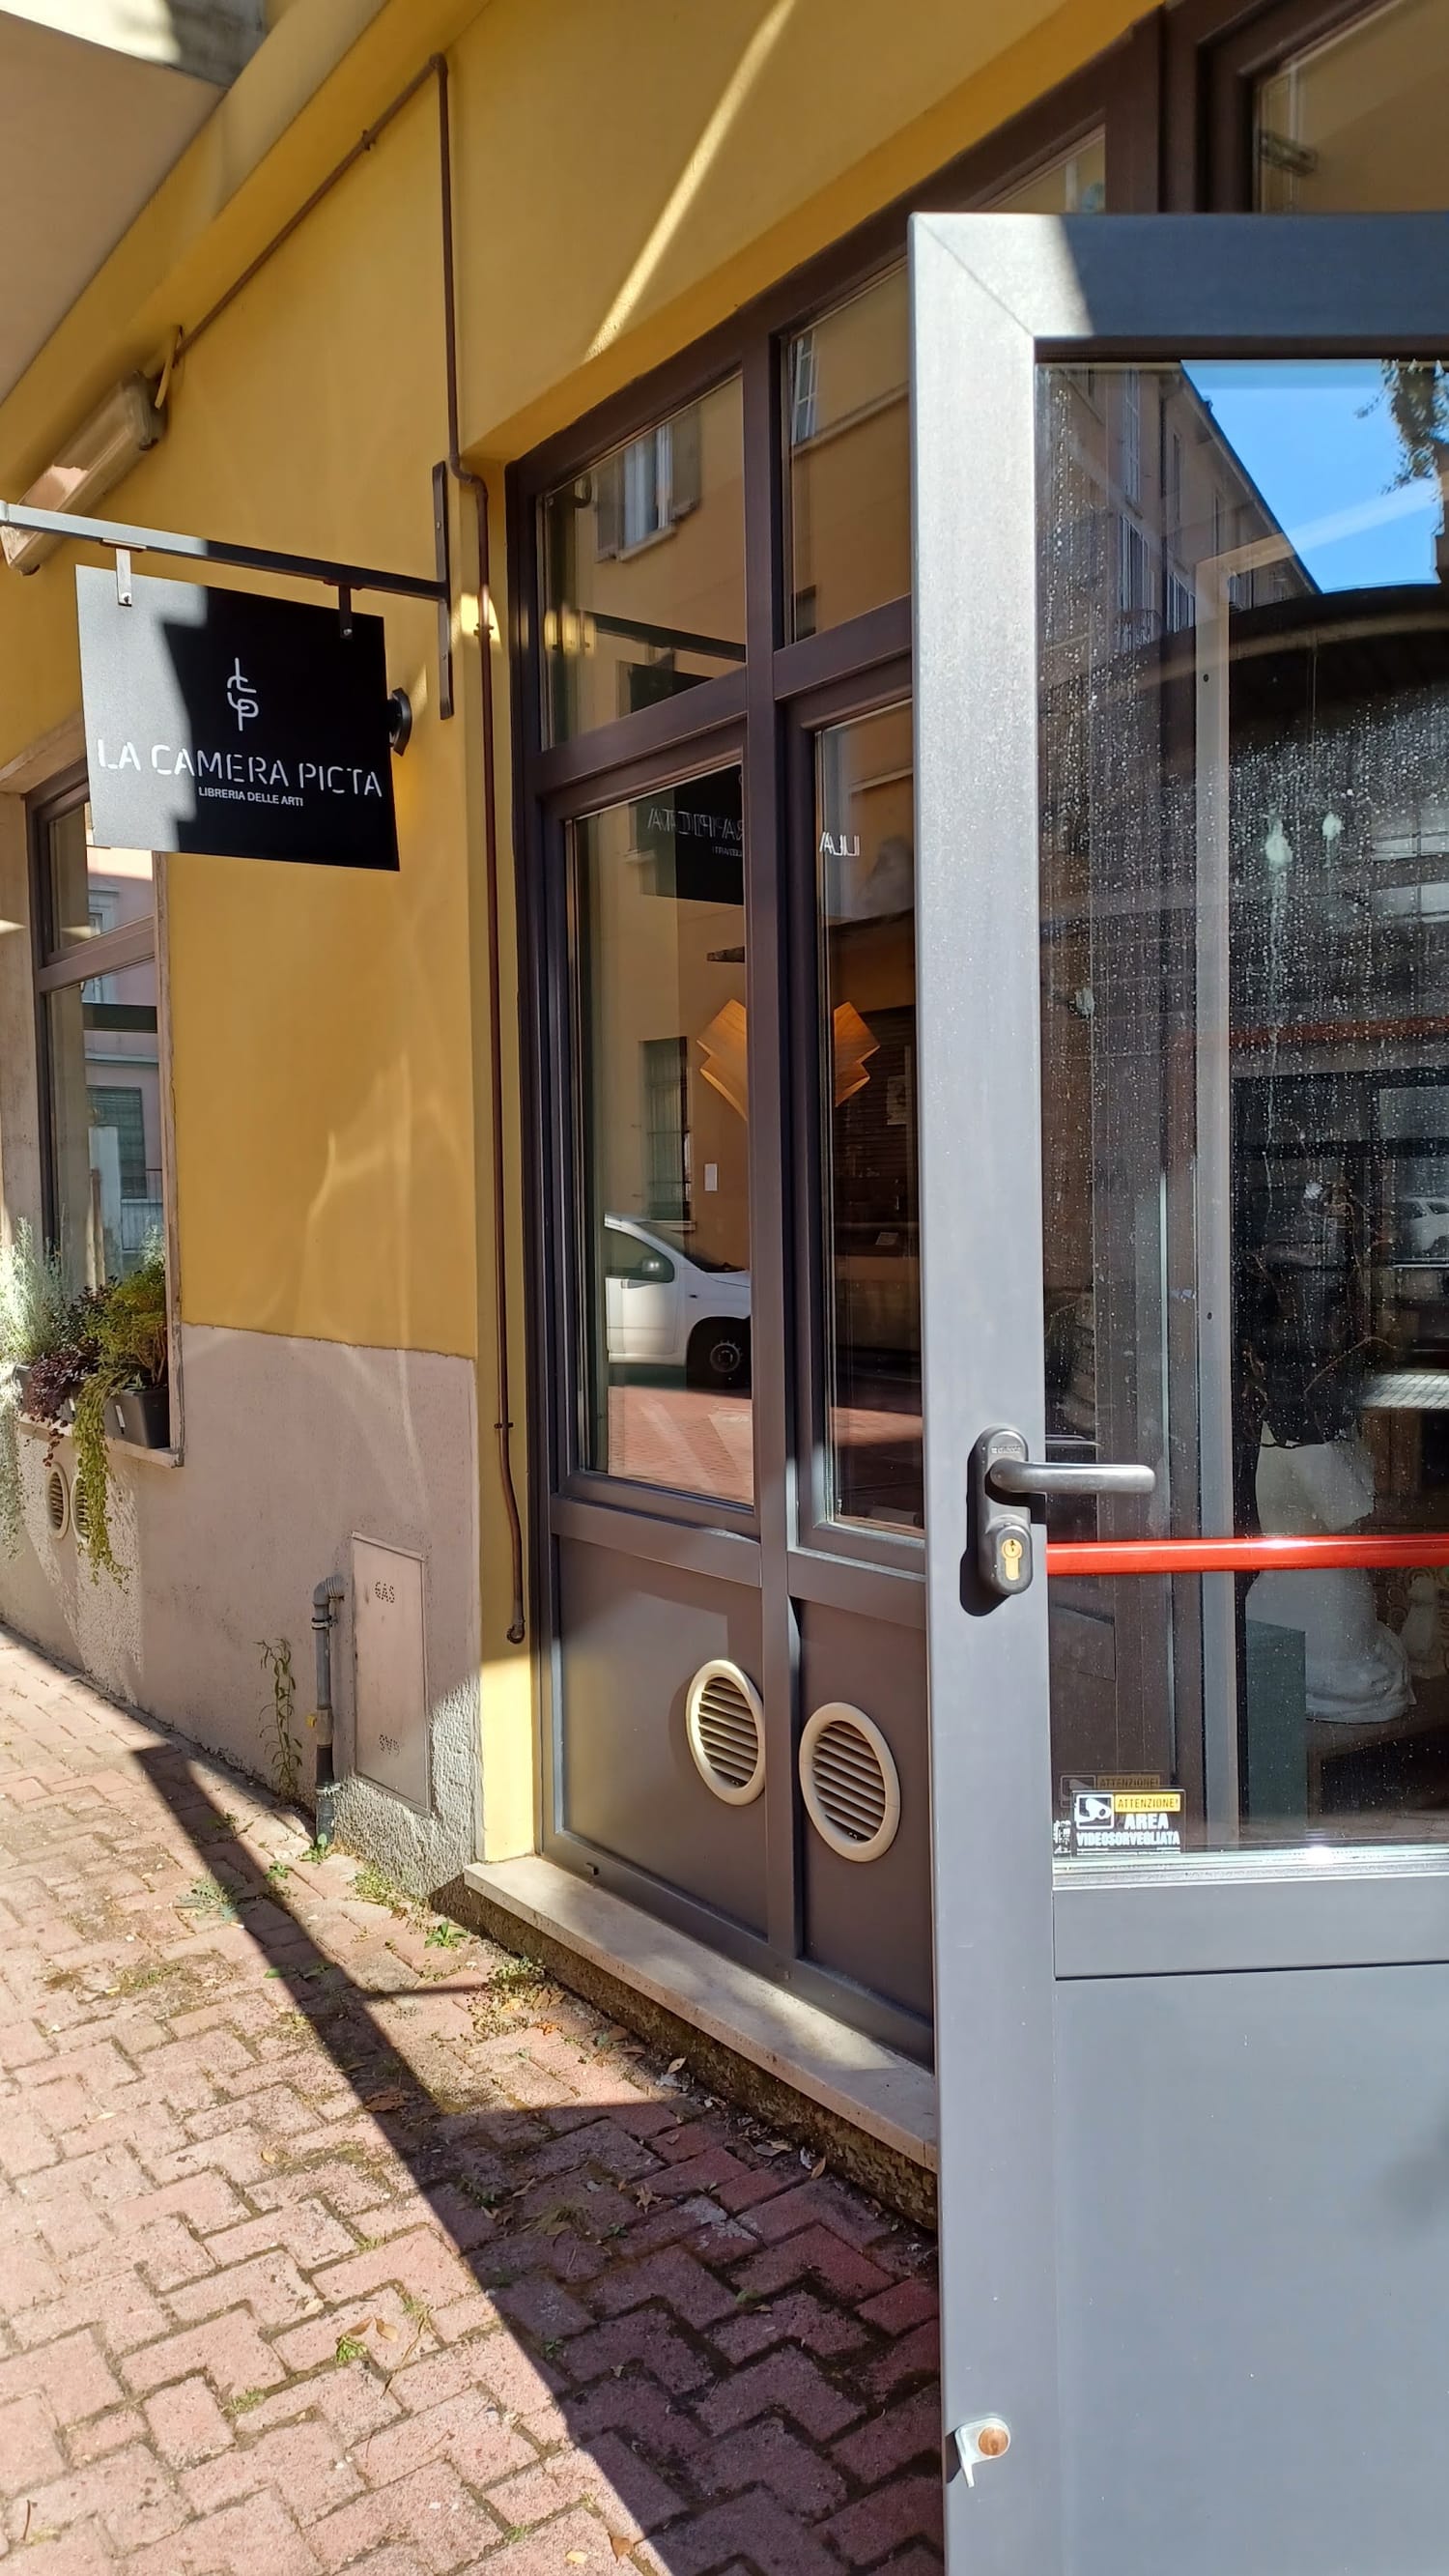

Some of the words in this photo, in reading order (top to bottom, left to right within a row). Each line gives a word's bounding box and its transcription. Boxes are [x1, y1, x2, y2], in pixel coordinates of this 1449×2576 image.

[97, 738, 141, 772] LA
[151, 743, 290, 787] CAMERA
[298, 762, 383, 797] PICTA
[198, 786, 245, 801] LIBRERIA
[246, 791, 280, 805] DELLE
[281, 795, 304, 807] ARTI
[375, 1581, 395, 1604] GAS
[1117, 1797, 1179, 1809] ATTENZIONE!
[1123, 1813, 1169, 1830] AREA
[1076, 1830, 1180, 1846] VIDEOSORVEGLIATA
